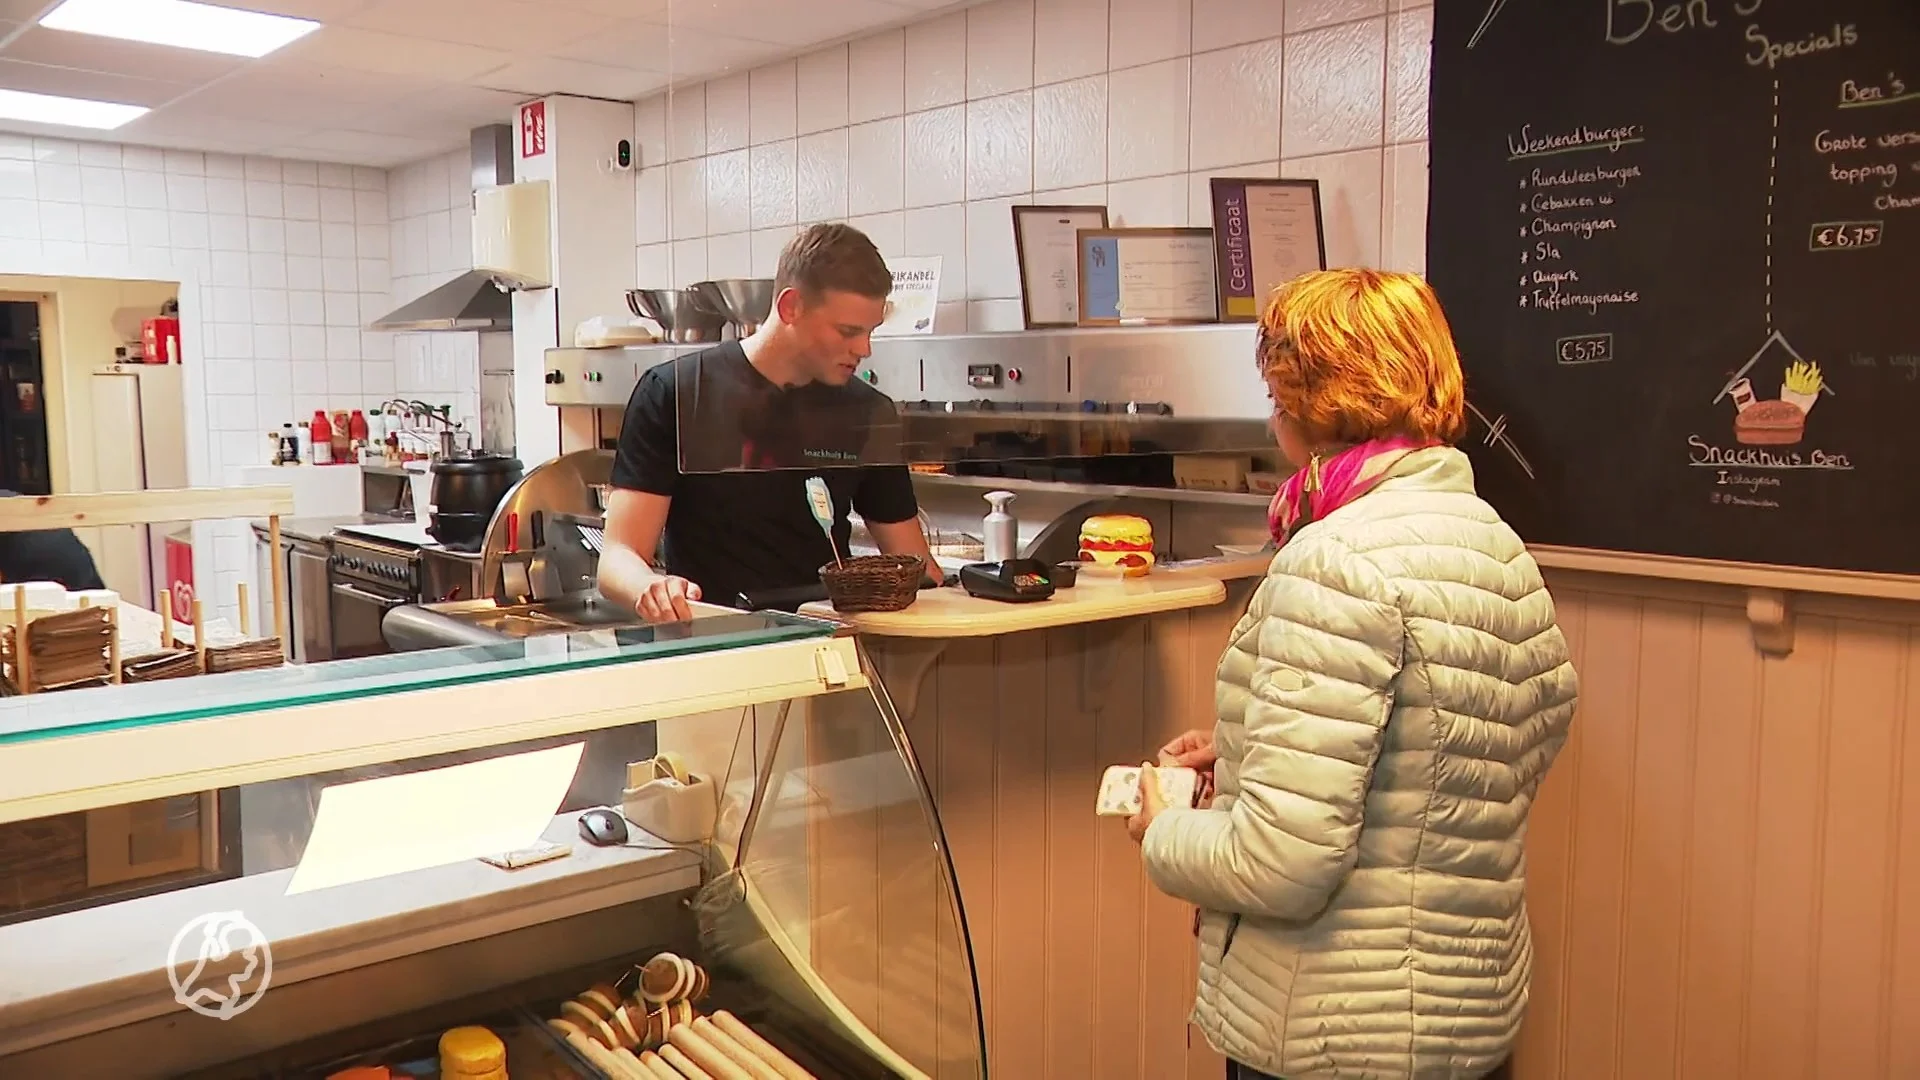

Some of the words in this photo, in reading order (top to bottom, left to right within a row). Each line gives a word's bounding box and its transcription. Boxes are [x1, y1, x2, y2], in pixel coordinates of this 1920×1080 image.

[1604, 0, 1762, 45] Ben
[1744, 23, 1859, 69] Specials
[1830, 162, 1898, 188] topping
[1531, 193, 1594, 213] Gebakken
[1531, 217, 1617, 240] Champignon
[1817, 223, 1879, 247] €6,75
[1225, 198, 1247, 291] Certificaat
[1535, 241, 1561, 260] Sla
[1532, 269, 1579, 295] Augurk
[1532, 289, 1639, 316] Truffelmayonaise
[1561, 340, 1606, 361] €5,75
[1688, 434, 1802, 467] Snackhuis
[1811, 449, 1850, 467] Ben
[1716, 470, 1781, 493] Instagram
